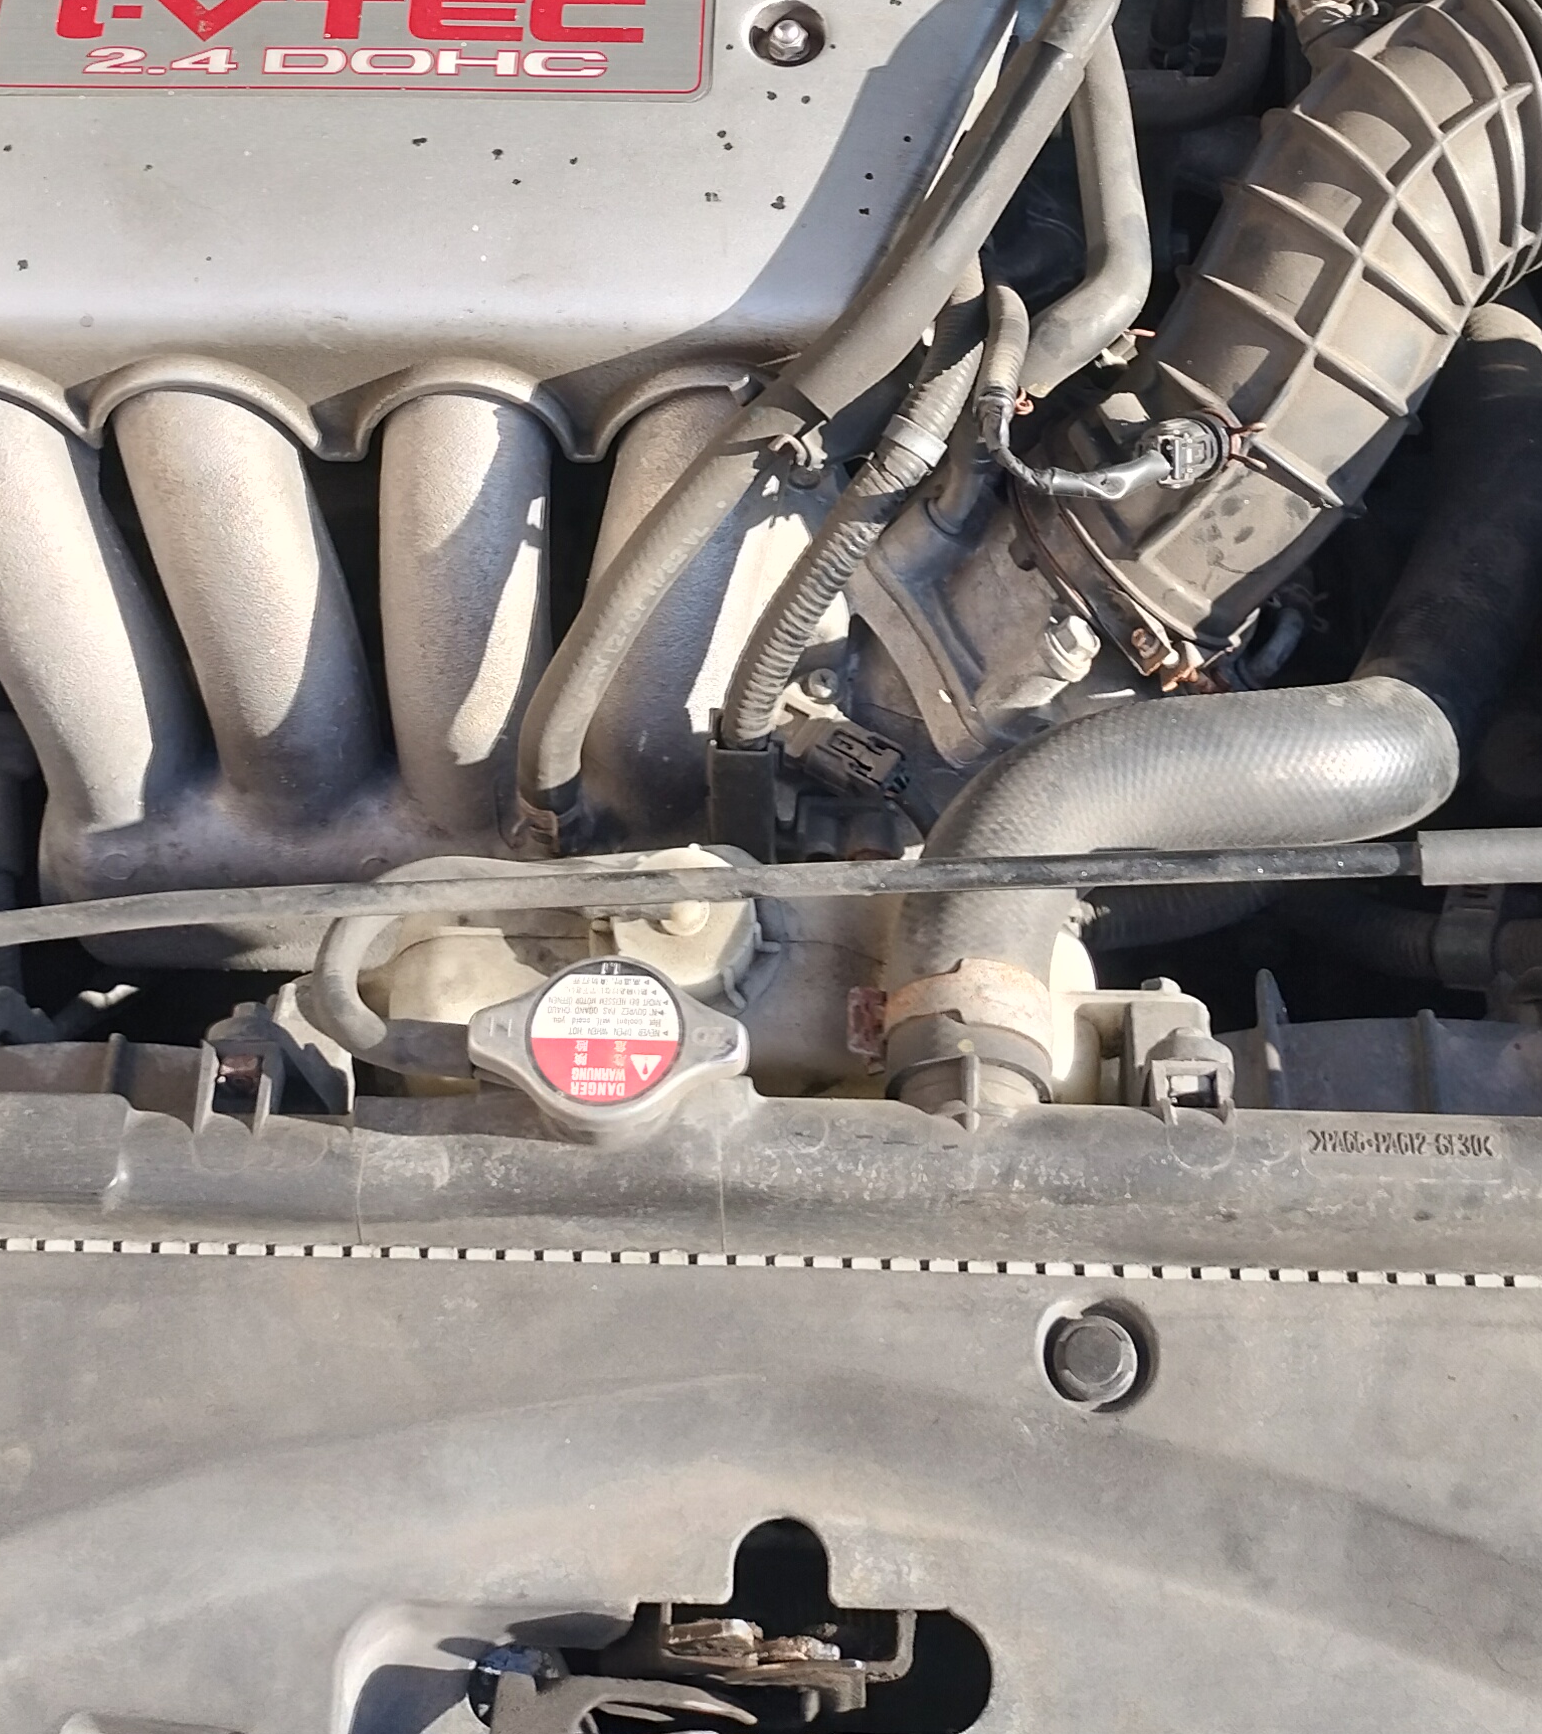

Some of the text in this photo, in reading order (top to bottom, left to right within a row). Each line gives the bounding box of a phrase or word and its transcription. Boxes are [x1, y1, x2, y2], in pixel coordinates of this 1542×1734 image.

[81, 46, 610, 77] 2.4 DOHC
[601, 962, 621, 975] 1.1
[575, 1006, 598, 1015] QUAND
[603, 1007, 616, 1015] PAS
[568, 1026, 660, 1038] NEVER OPEN WHEN HOT
[571, 1067, 626, 1081] WARNUNG
[570, 1081, 626, 1097] DANGER
